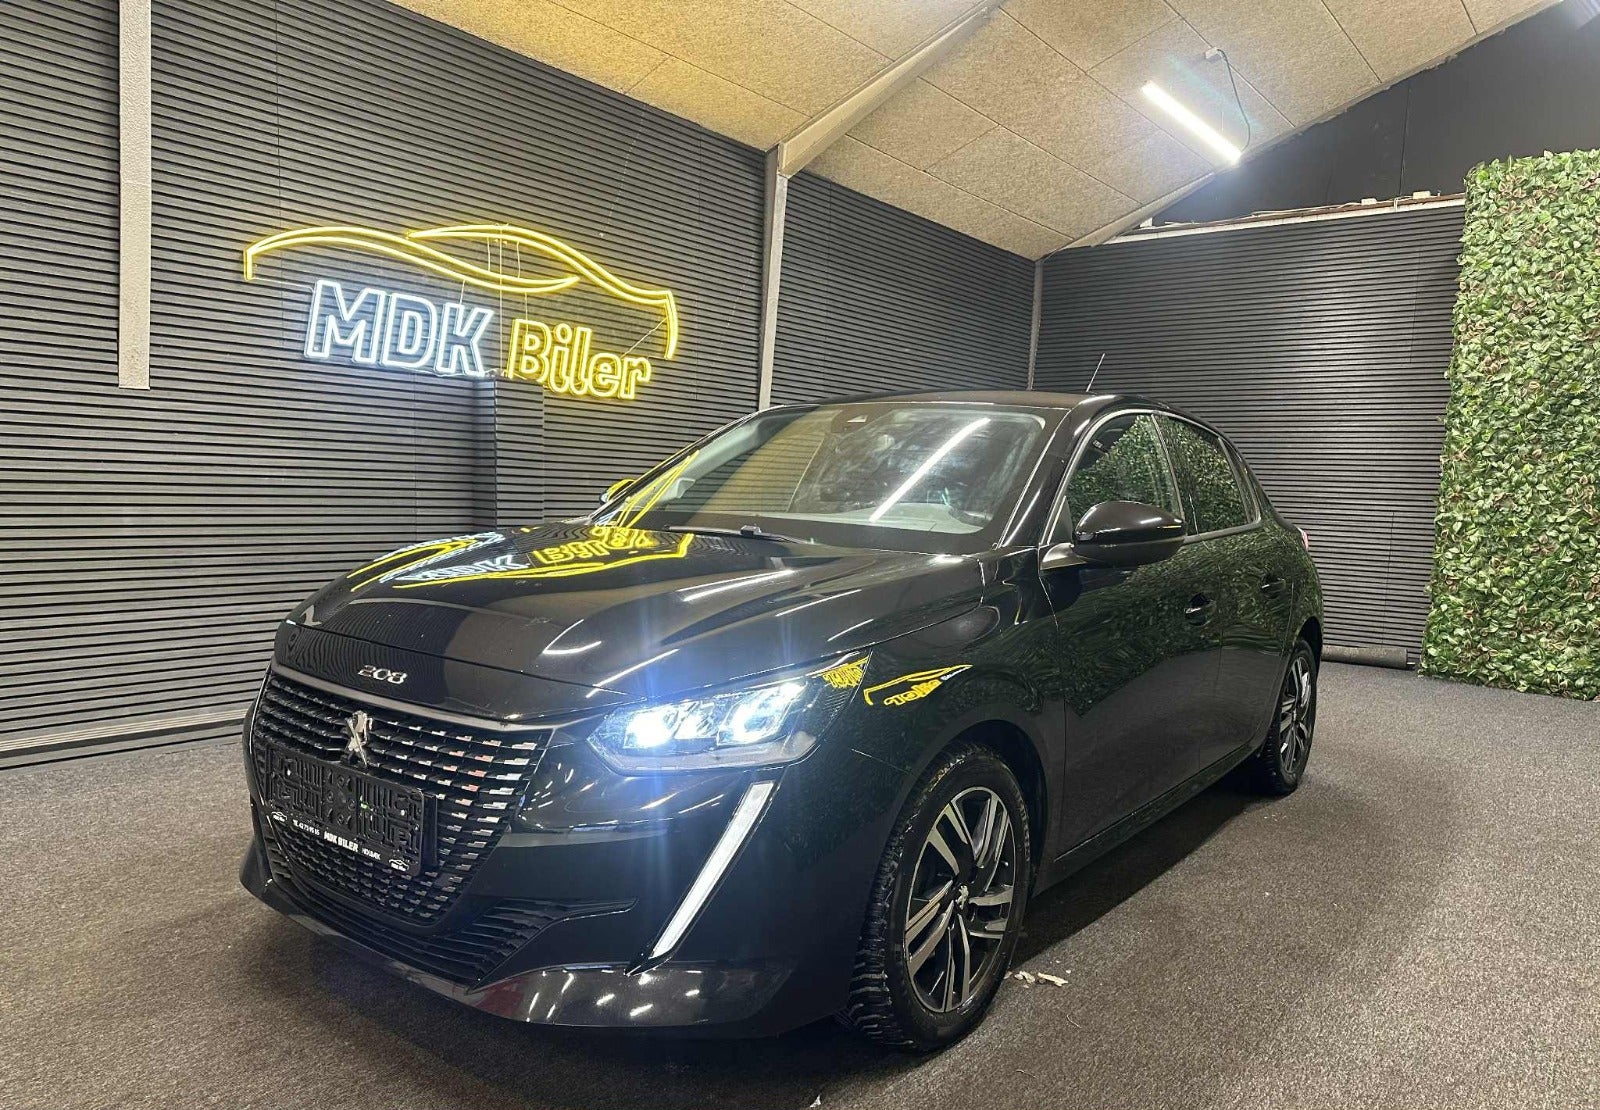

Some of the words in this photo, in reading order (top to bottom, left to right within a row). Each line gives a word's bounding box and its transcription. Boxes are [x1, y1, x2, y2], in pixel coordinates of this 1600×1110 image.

[304, 279, 494, 377] MDK
[507, 318, 652, 400] Biler
[357, 664, 408, 684] 208
[338, 836, 359, 853] BILER
